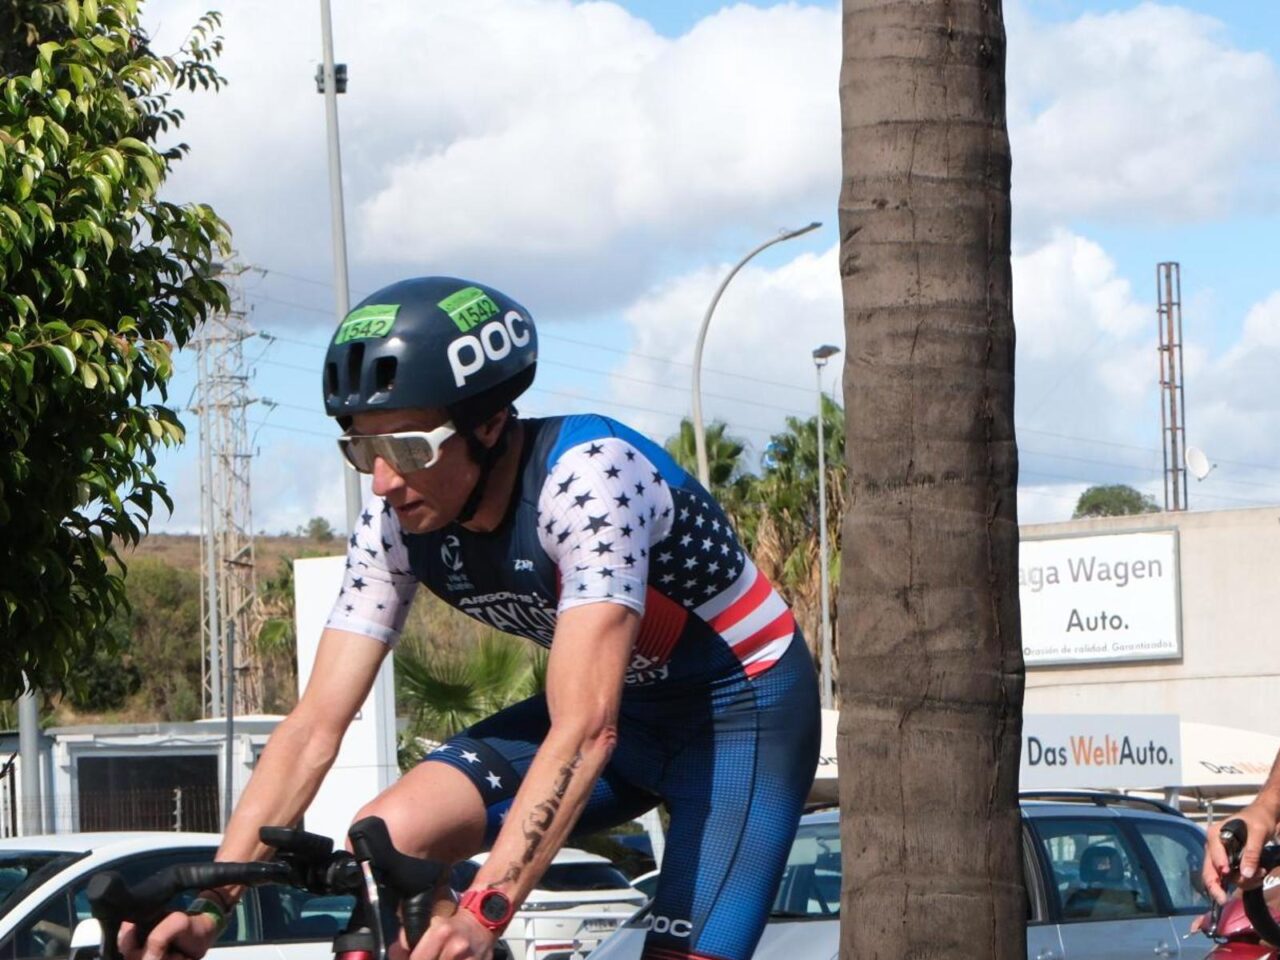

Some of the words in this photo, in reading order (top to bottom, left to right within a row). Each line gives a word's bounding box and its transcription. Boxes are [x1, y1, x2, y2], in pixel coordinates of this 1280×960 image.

[342, 319, 387, 338] 1542
[457, 299, 498, 330] 1542
[1067, 555, 1163, 588] Wagen
[1066, 608, 1130, 633] Auto.
[1027, 736, 1068, 767] Das
